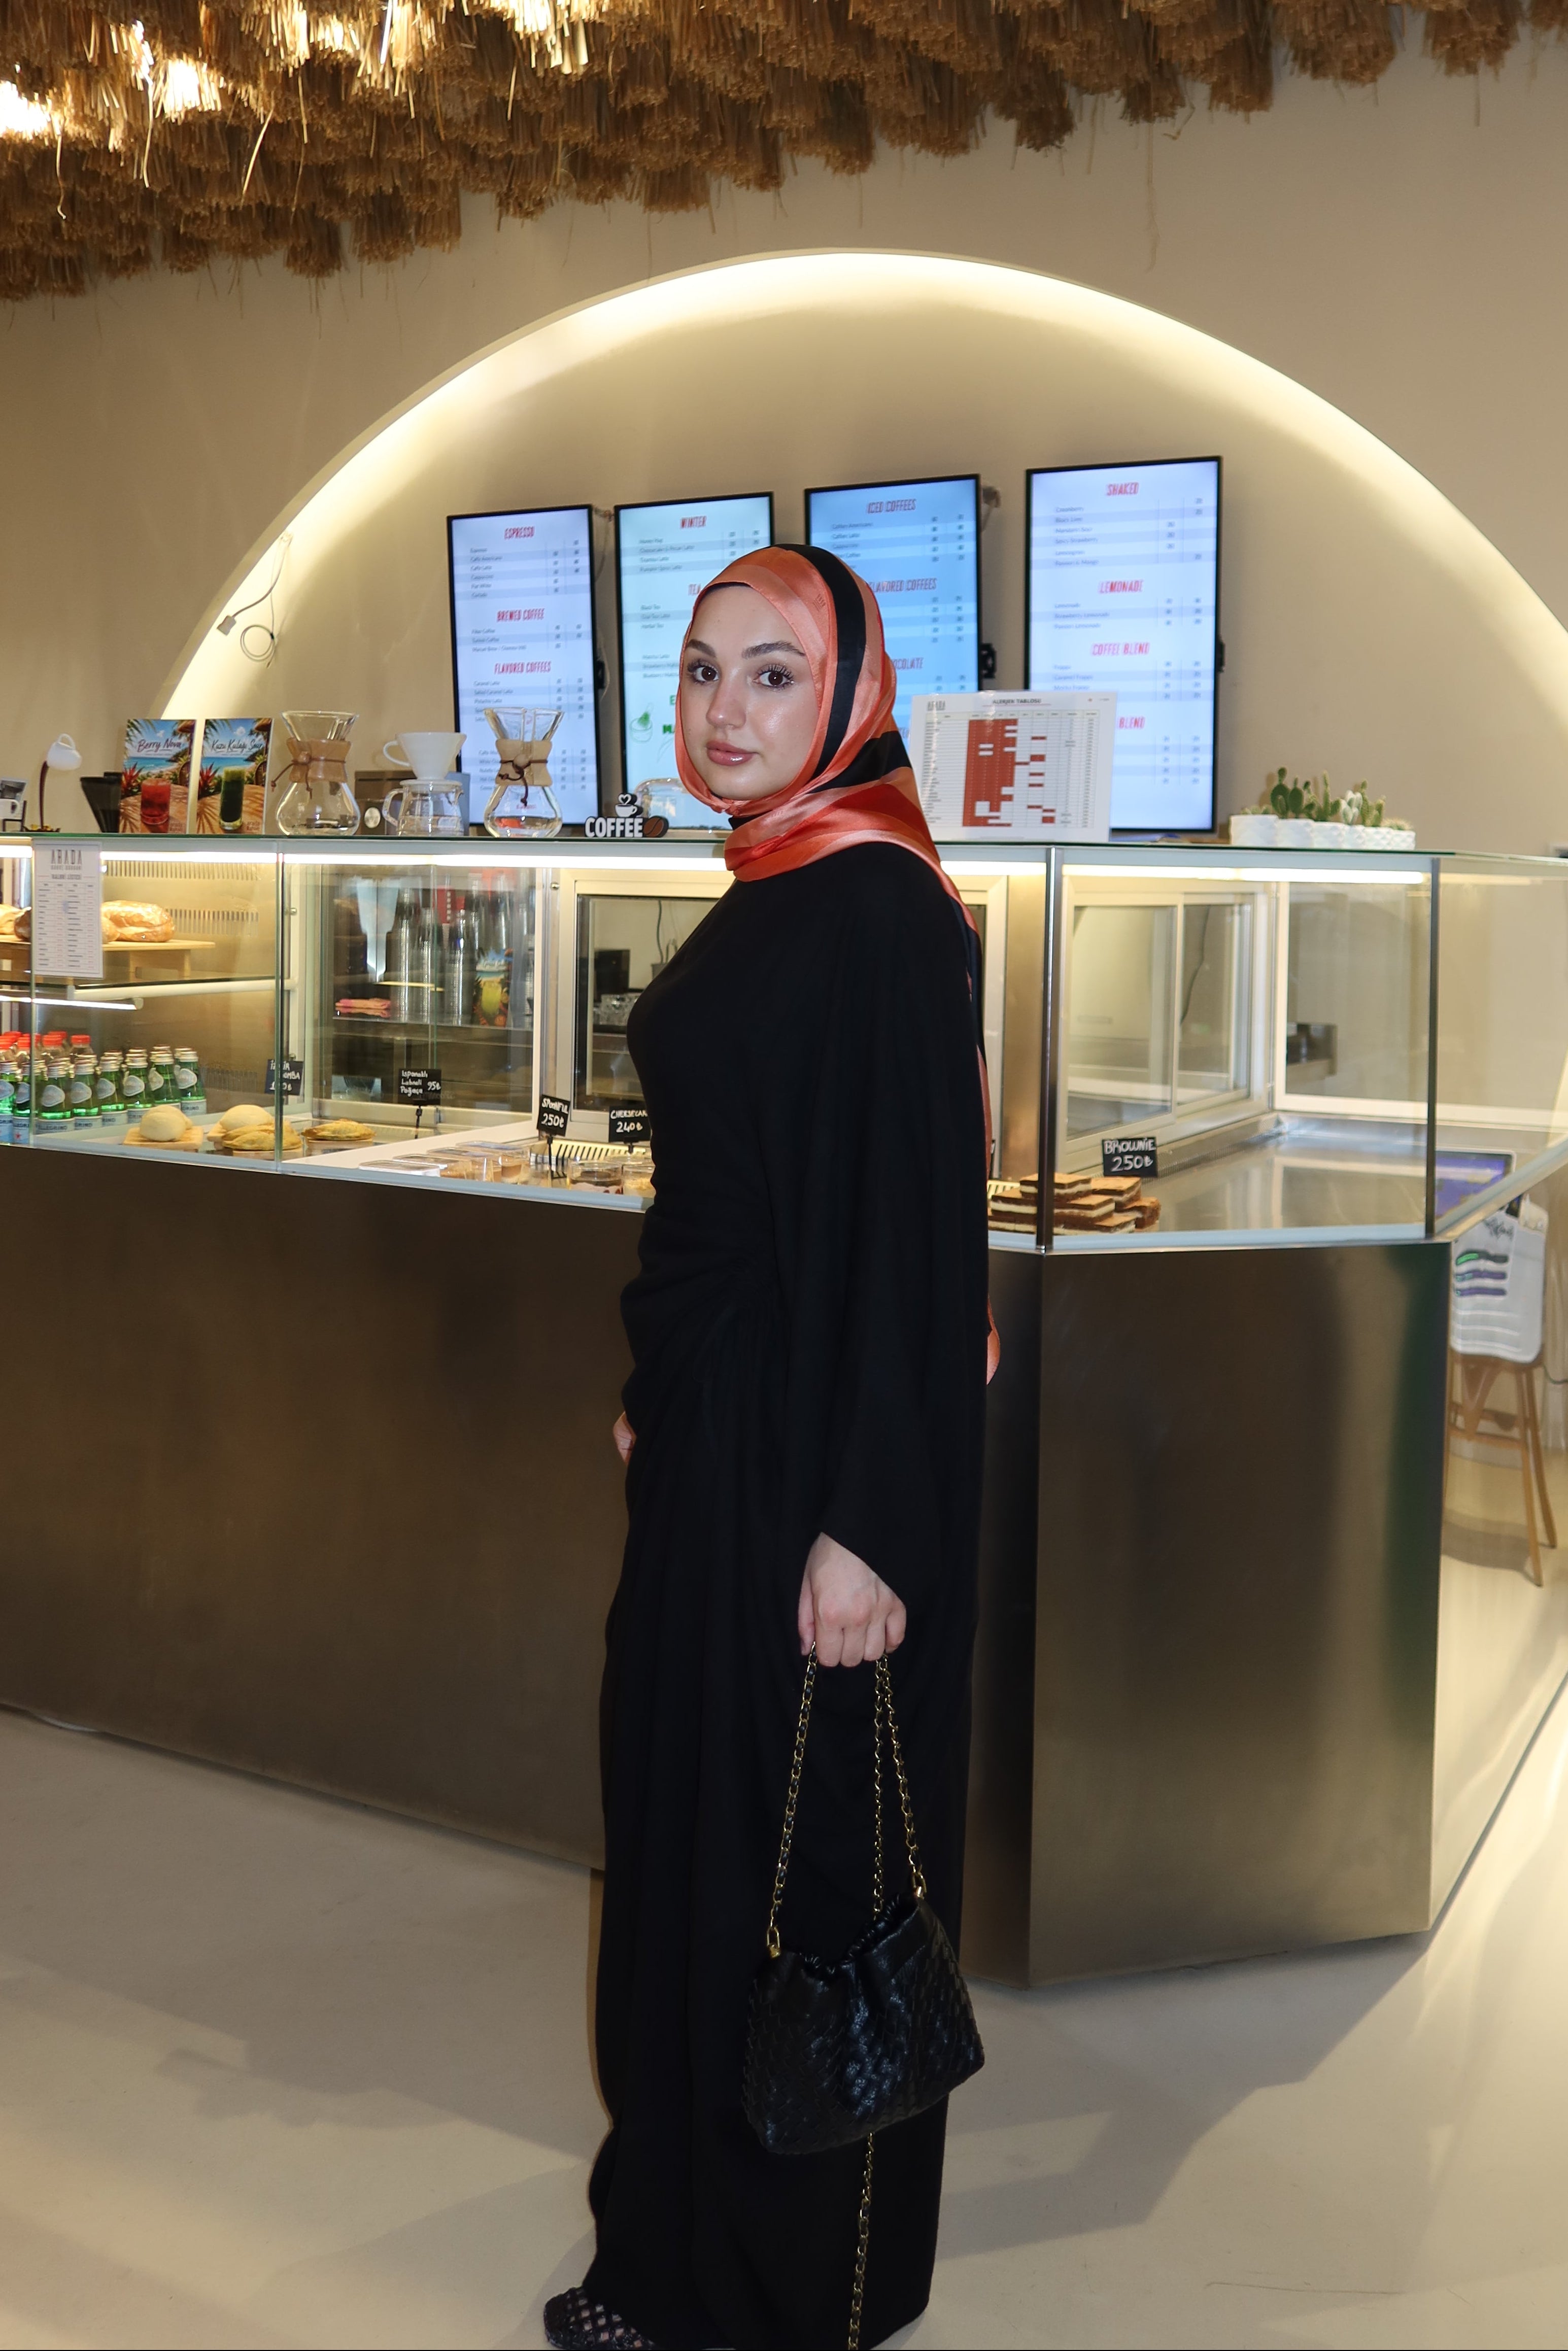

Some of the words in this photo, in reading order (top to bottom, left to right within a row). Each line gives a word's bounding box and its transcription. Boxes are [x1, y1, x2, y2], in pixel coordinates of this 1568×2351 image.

[1106, 483, 1139, 495] SHAKED
[867, 501, 883, 514] ICED
[885, 499, 916, 512] COFFEES
[680, 516, 706, 528] WINTER
[504, 526, 534, 539] ESPRESSO
[906, 578, 937, 591] COFFEES
[1099, 580, 1143, 593] LEMONADE
[497, 610, 522, 622] BREWED
[523, 608, 544, 621] COFFEE
[1092, 643, 1120, 656] COFFEE
[1123, 642, 1150, 655] BLEND
[494, 663, 524, 674] FLAVORED
[526, 661, 552, 673] COFFEES
[893, 657, 924, 669] OCOLATE
[137, 739, 161, 753] Berry
[163, 738, 182, 748] Nova
[585, 817, 643, 837] COFFEE
[51, 849, 82, 865] ARADA
[610, 1110, 648, 1119] CHEESECAK
